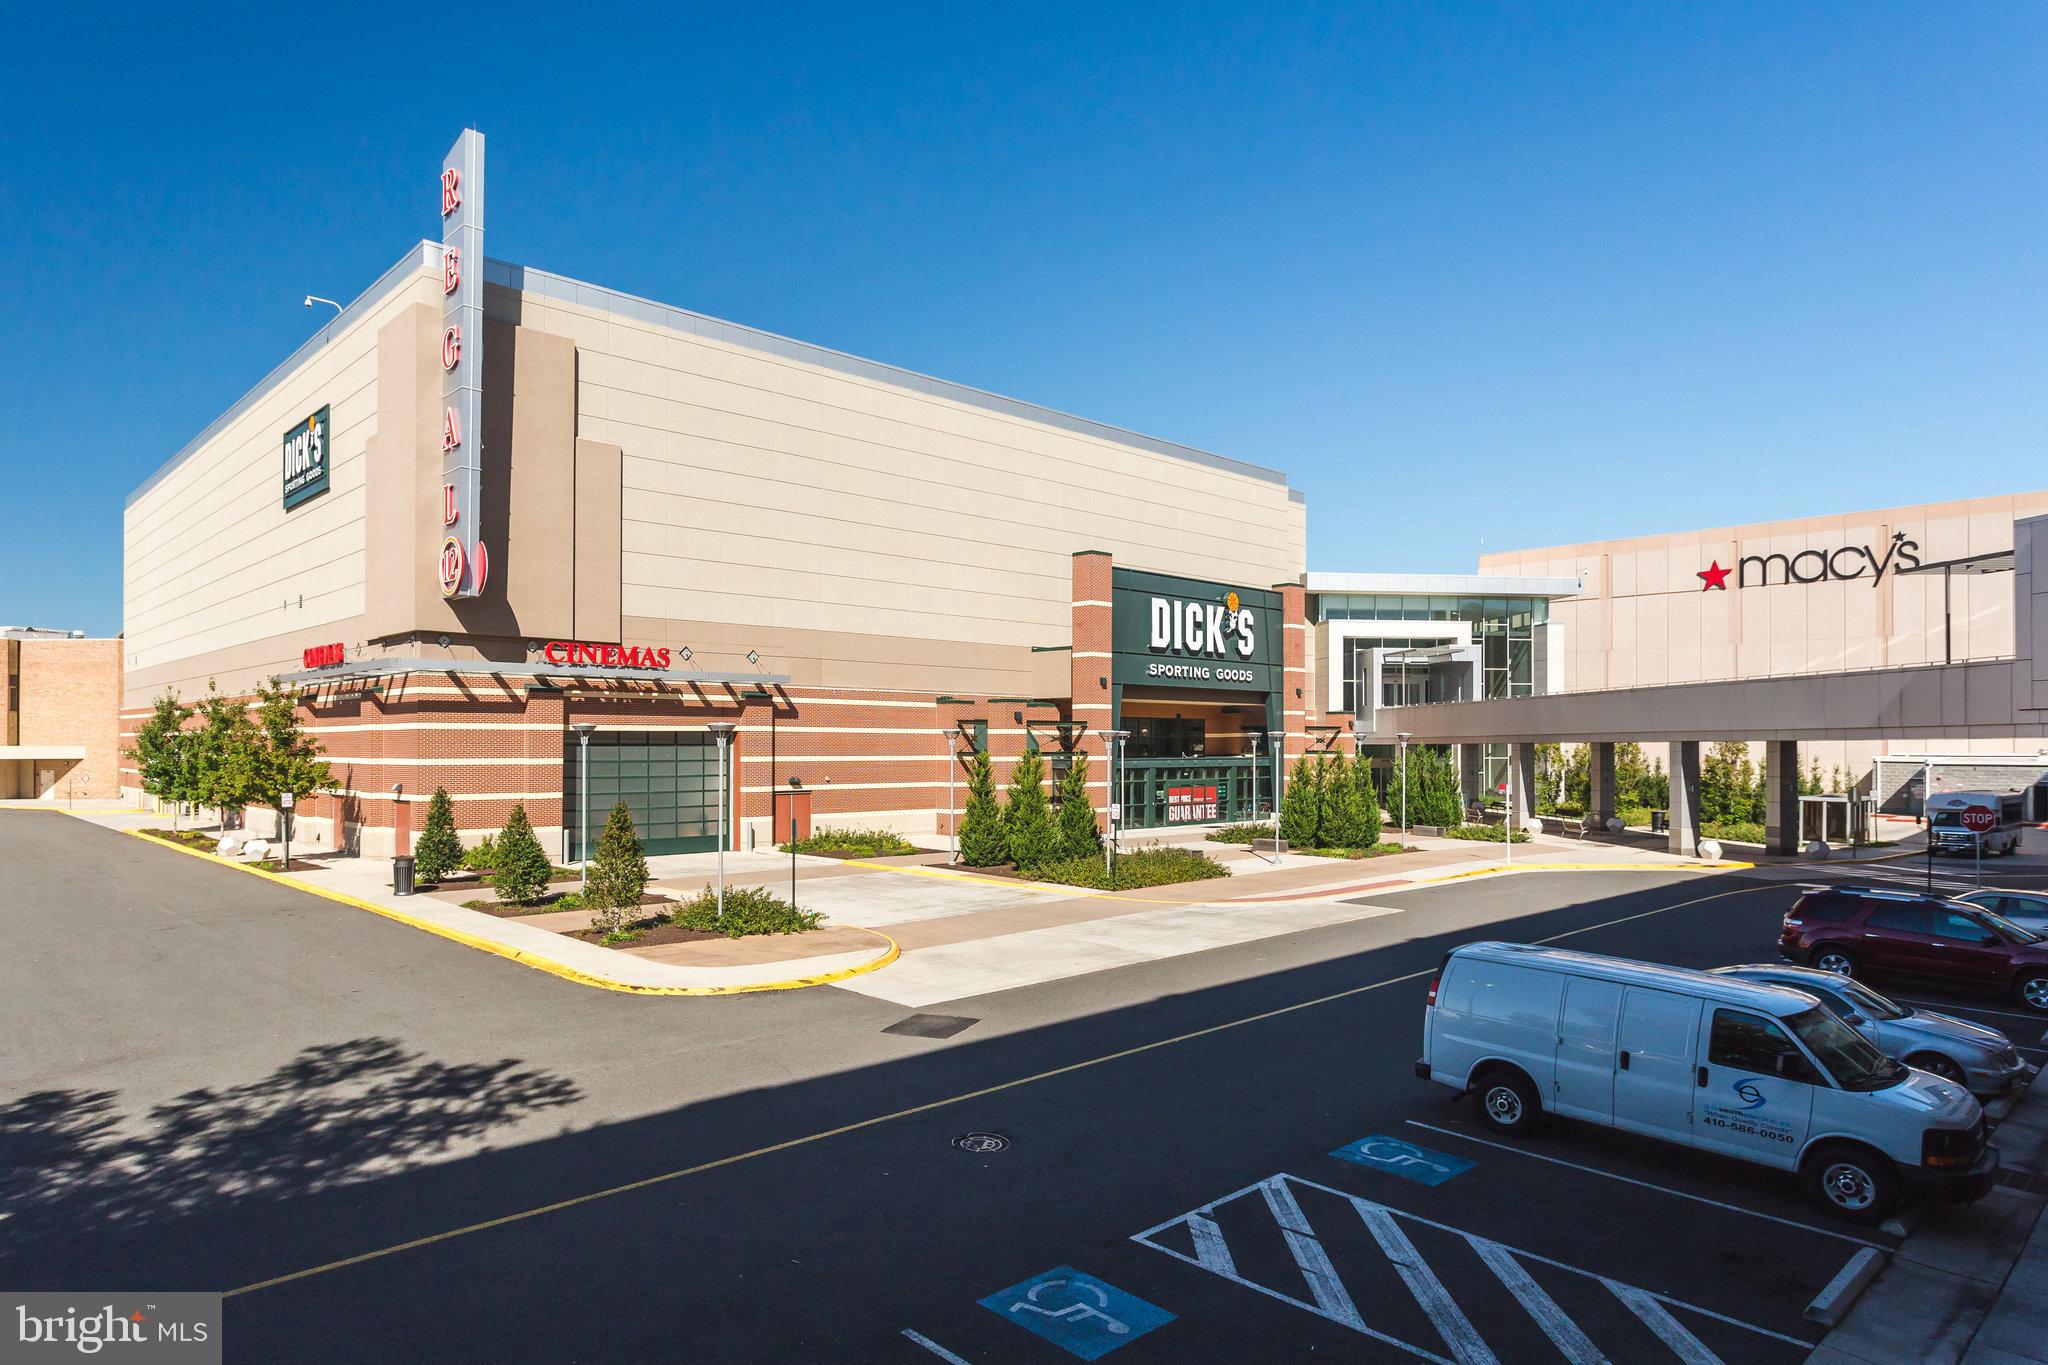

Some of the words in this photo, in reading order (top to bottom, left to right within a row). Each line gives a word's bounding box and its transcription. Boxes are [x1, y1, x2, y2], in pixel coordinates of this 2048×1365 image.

[441, 167, 461, 527] REGAL
[285, 423, 323, 481] DICK'S
[442, 547, 459, 583] 12
[1739, 531, 1920, 588] macy's
[1151, 597, 1254, 656] DICK'S
[545, 641, 670, 668] CINEMAS
[1149, 663, 1210, 679] SPORTING
[1216, 668, 1253, 682] GOODS
[1963, 813, 1993, 824] STOP
[1704, 1117, 1794, 1143] 410-586-0050
